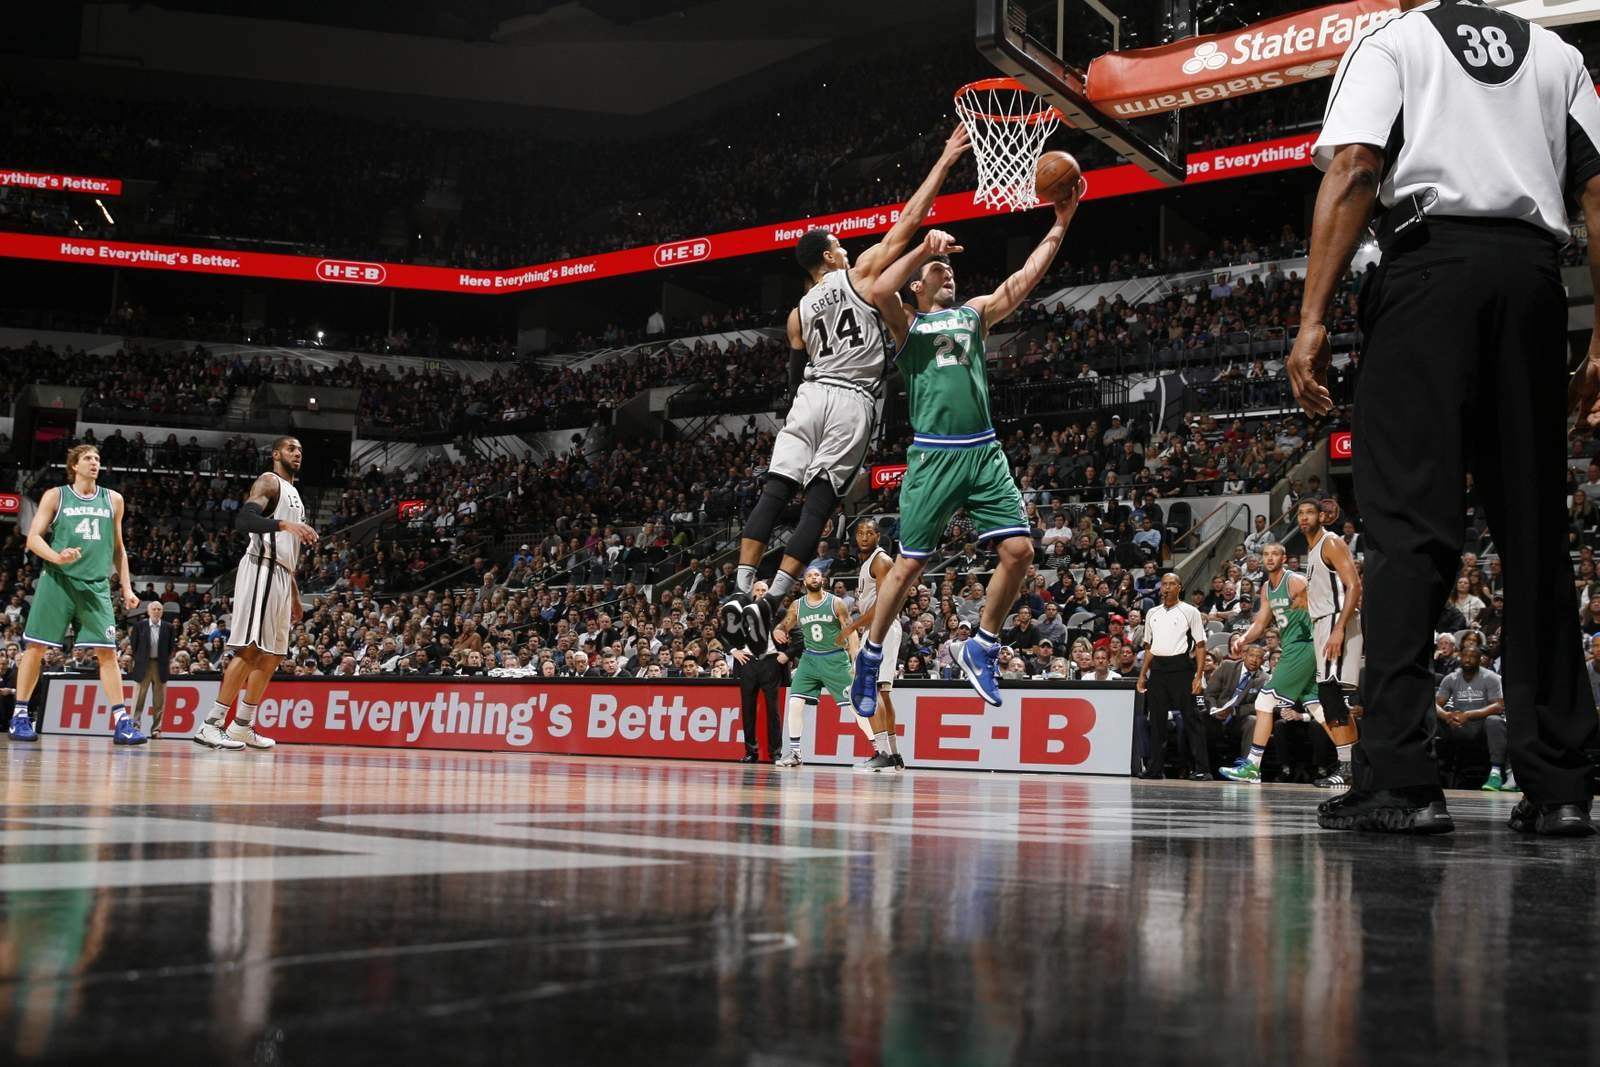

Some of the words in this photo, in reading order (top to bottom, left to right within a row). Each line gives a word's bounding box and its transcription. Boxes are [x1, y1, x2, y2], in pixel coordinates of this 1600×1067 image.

[1457, 24, 1514, 67] 38
[1186, 161, 1210, 175] ere
[1215, 142, 1316, 170] Everything'
[774, 228, 803, 241] Here
[61, 243, 95, 256] Here
[99, 246, 188, 265] Everything's
[192, 253, 240, 268] Better.
[460, 274, 491, 287] Here
[494, 268, 559, 287] Everything's
[561, 263, 596, 277] Better.
[811, 288, 847, 313] GREEN
[814, 307, 865, 358] 14
[933, 333, 971, 368] 27
[75, 518, 101, 540] 41
[811, 624, 823, 642] 8
[324, 690, 573, 746] Everything's
[586, 694, 745, 743] Better.
